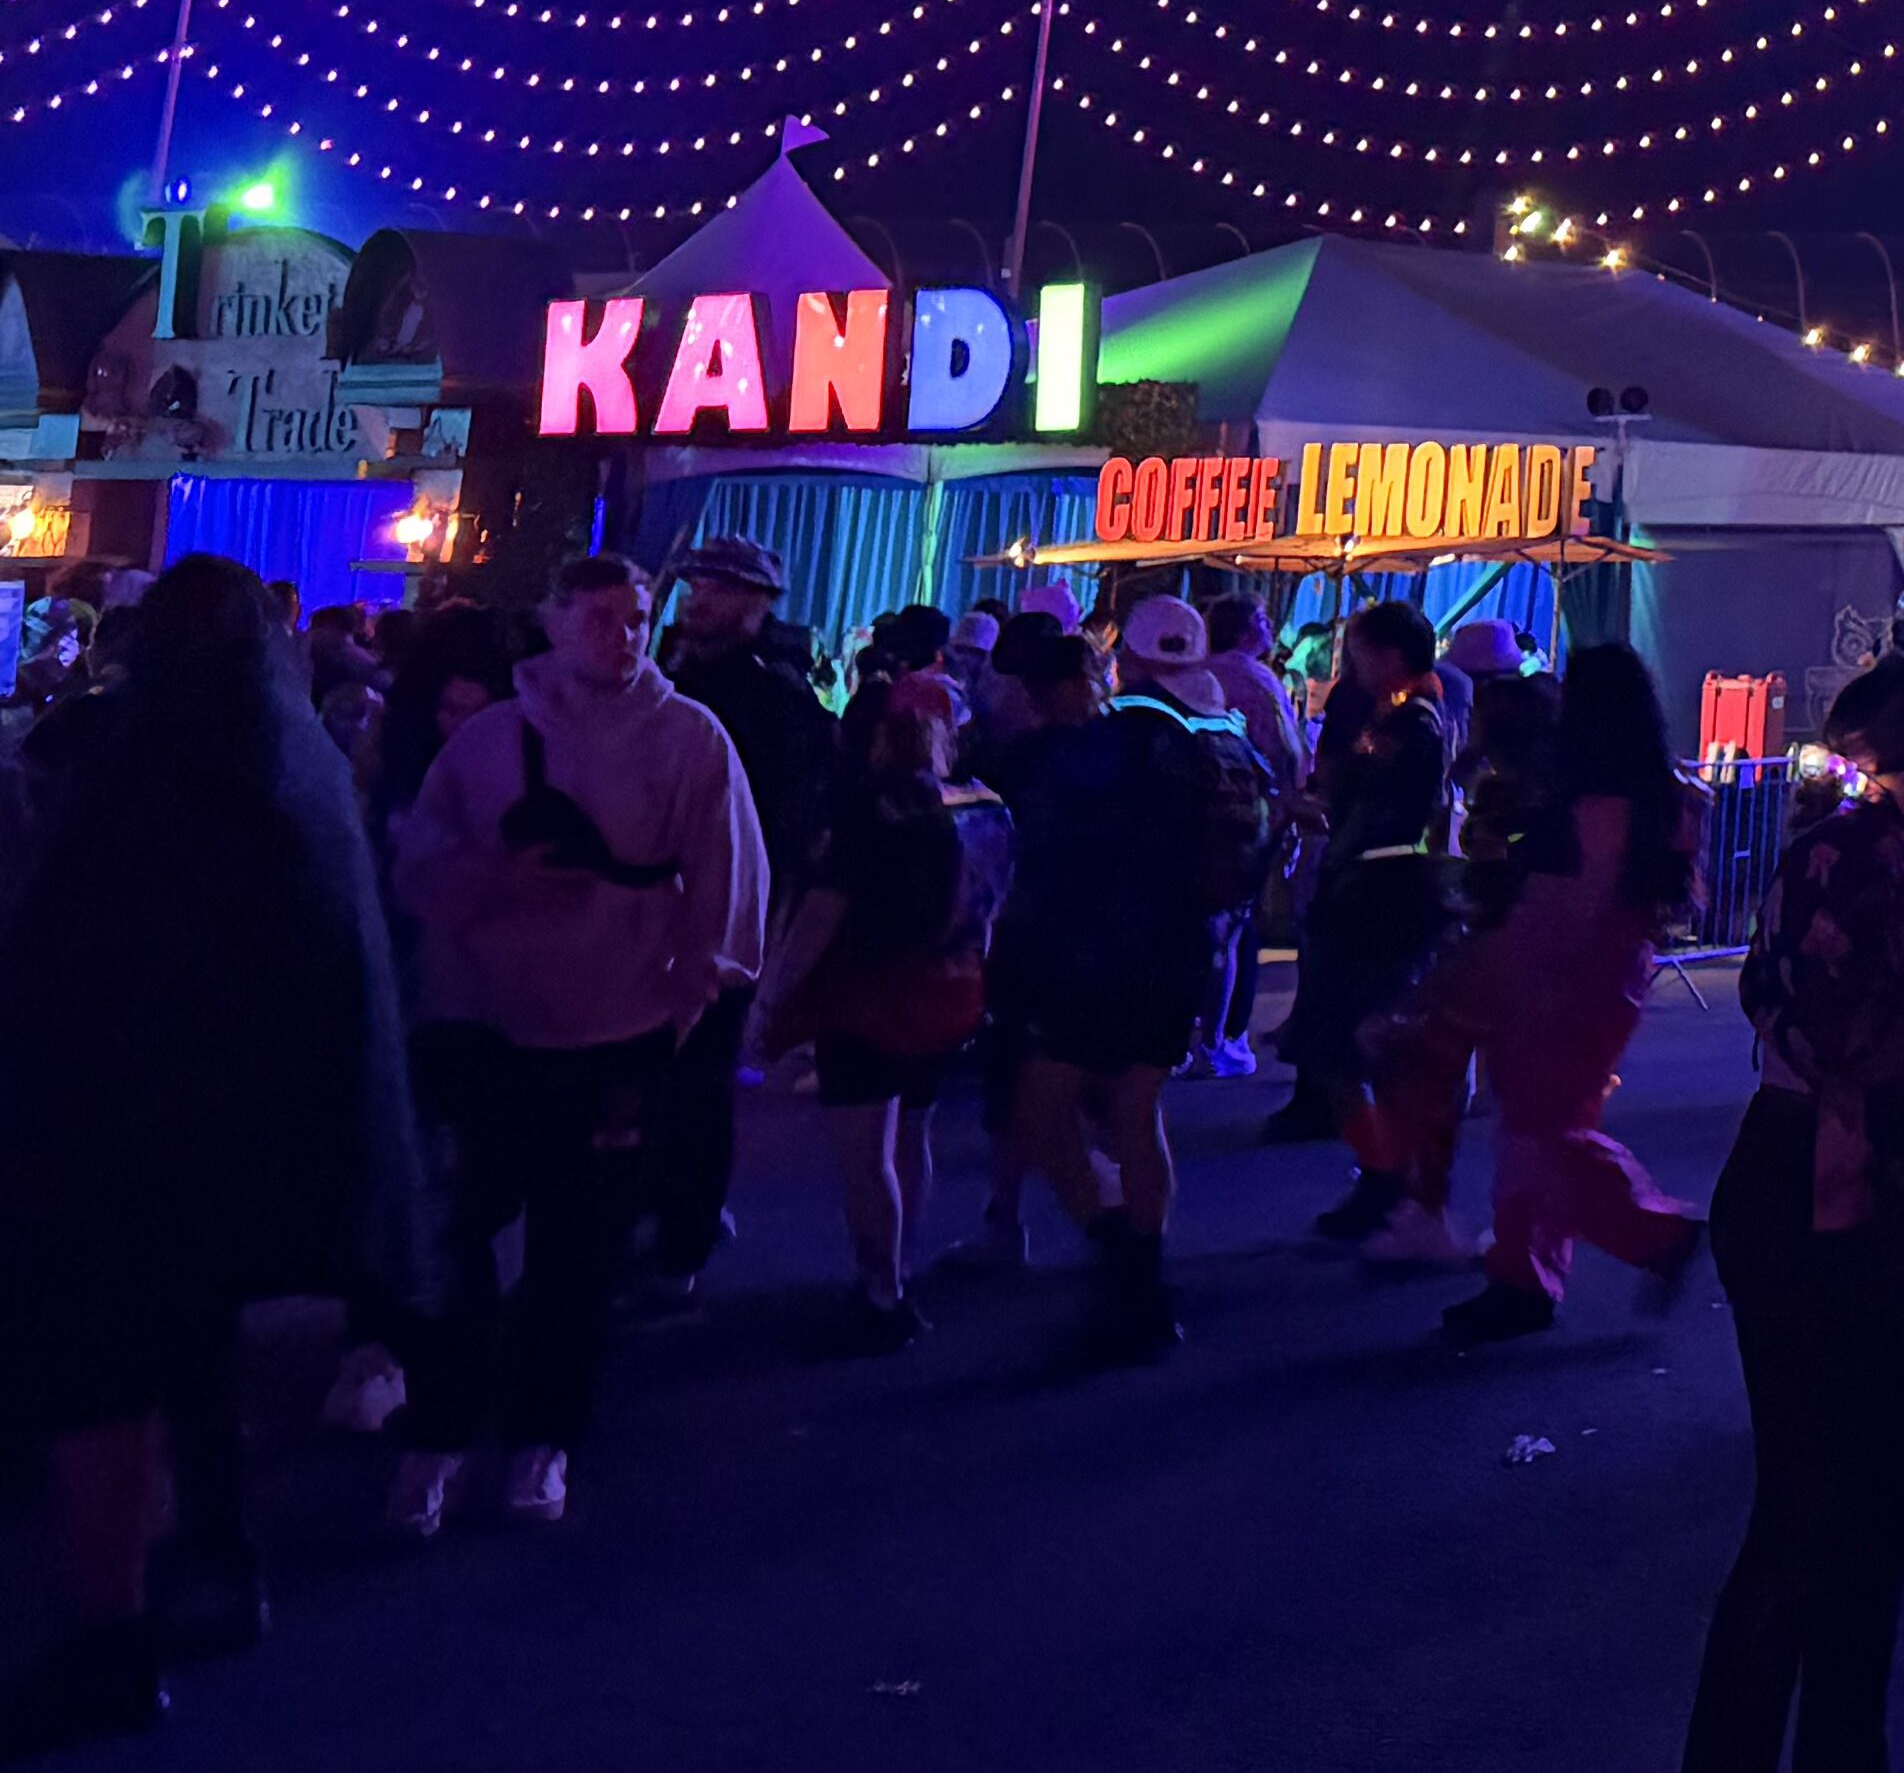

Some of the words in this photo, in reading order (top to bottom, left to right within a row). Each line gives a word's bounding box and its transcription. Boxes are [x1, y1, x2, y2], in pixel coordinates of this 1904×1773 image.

[539, 283, 1085, 436] KANDI
[226, 369, 359, 454] Trade
[1096, 456, 1280, 542] COFFEE
[1297, 441, 1595, 539] LEMONADE
